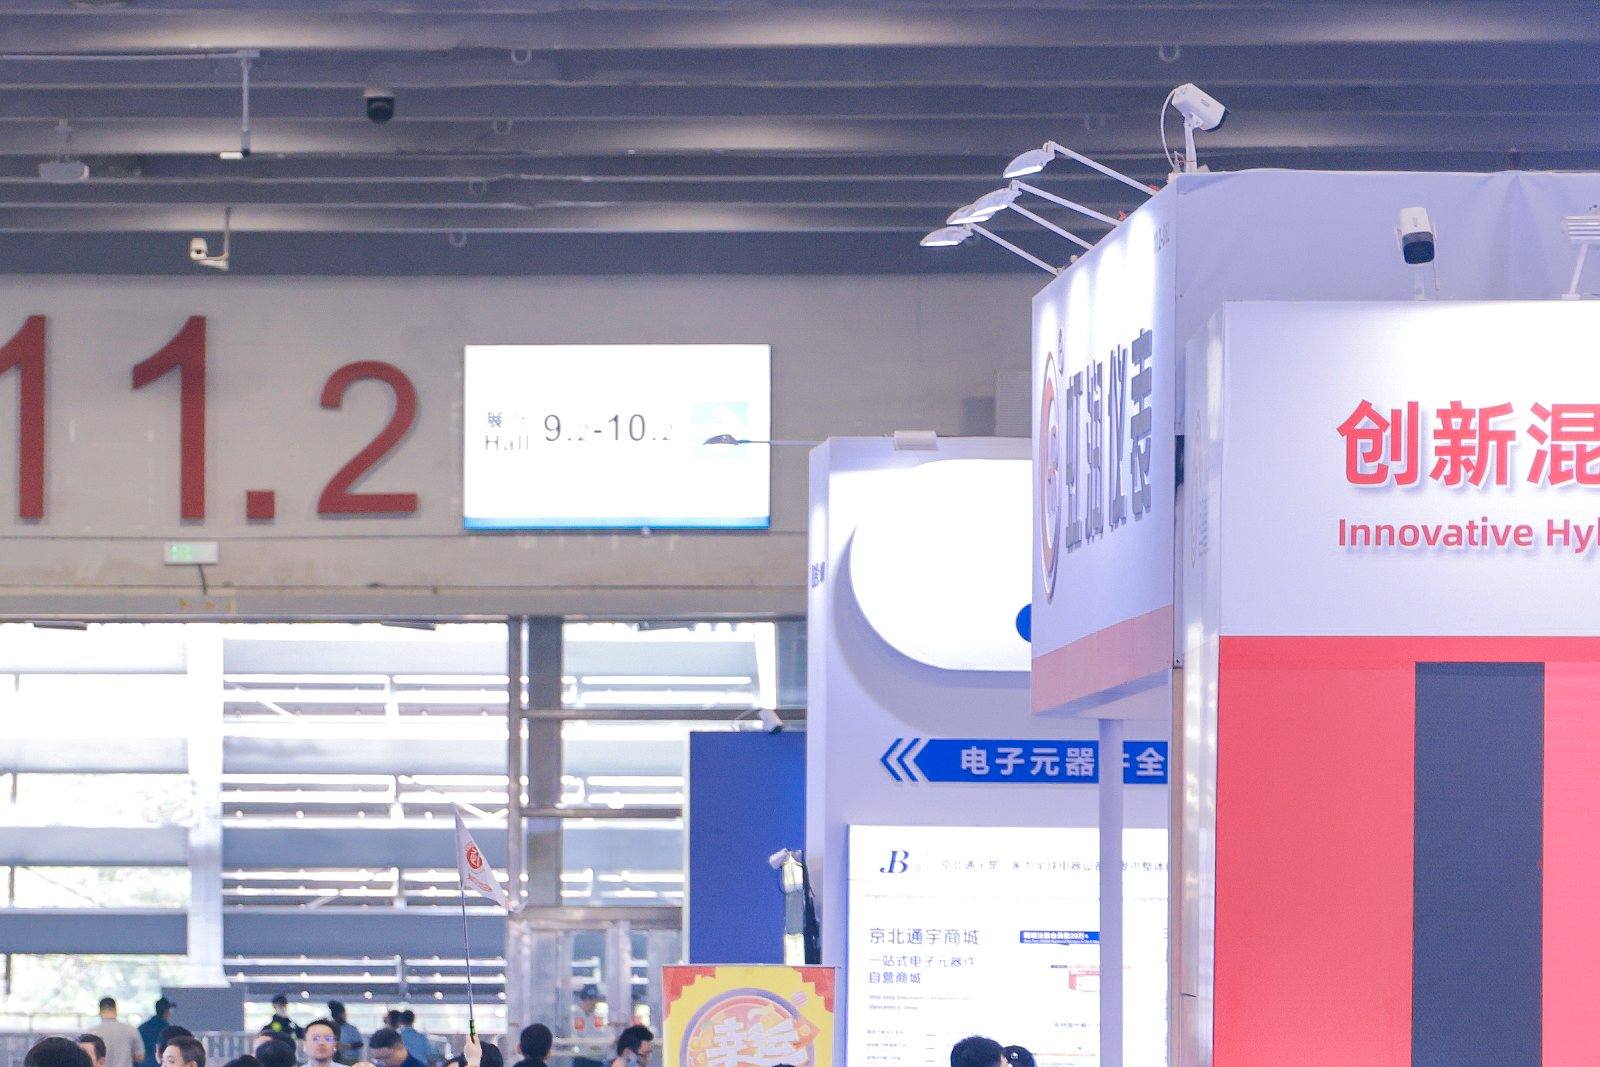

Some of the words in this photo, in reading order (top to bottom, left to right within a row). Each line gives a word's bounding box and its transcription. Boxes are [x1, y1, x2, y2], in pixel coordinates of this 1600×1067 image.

[1336, 399, 1600, 487] 创新混
[1338, 516, 1534, 547] Innovative
[1546, 517, 1600, 554] Hy
[960, 745, 1166, 778] 电子元器全
[869, 927, 980, 946] 京北通宇商城
[869, 954, 975, 968] 一站式电子元器件
